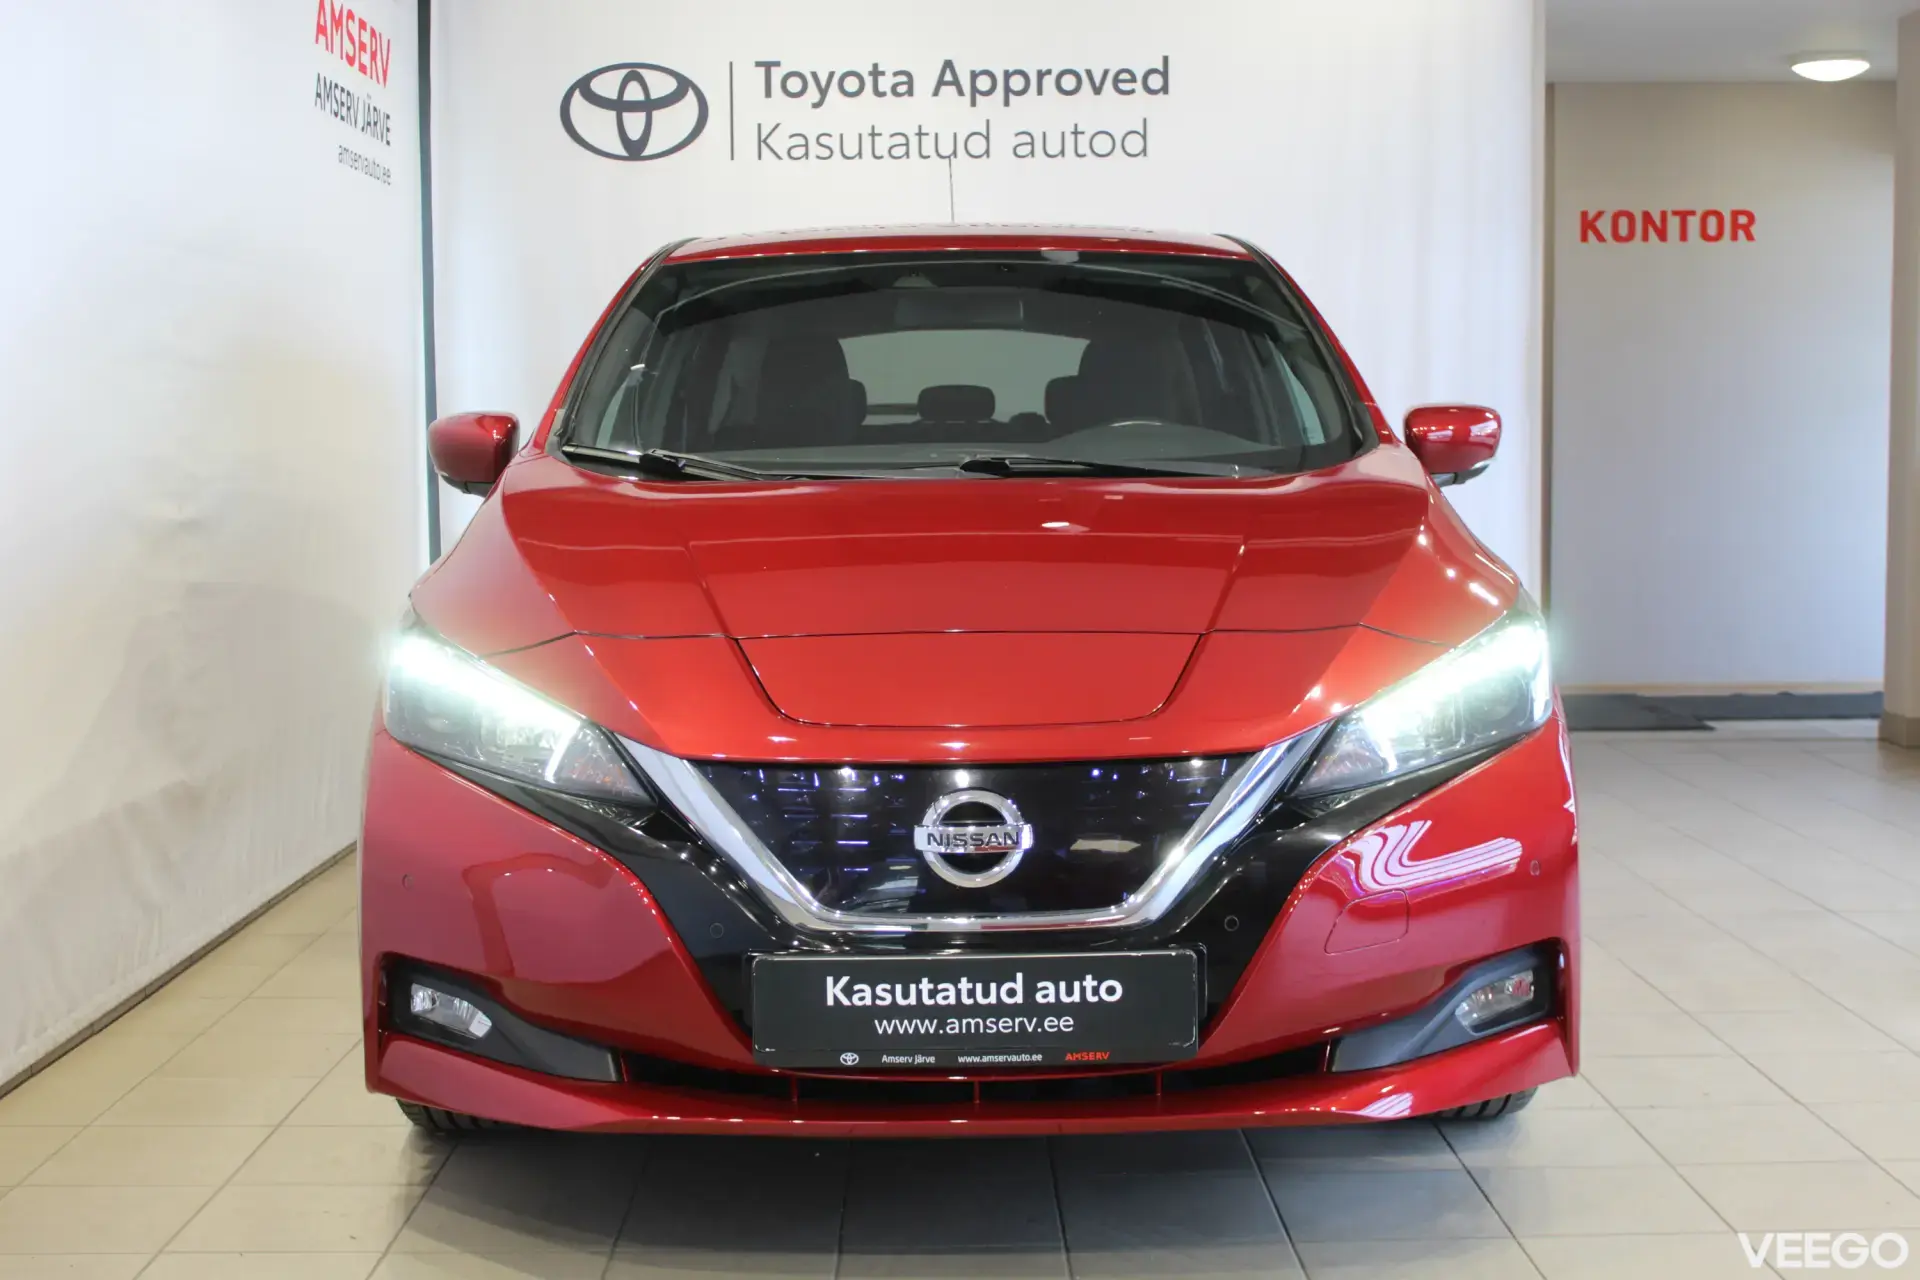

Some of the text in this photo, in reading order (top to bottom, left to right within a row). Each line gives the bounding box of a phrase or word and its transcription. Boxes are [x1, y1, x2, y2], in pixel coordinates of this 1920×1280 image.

[315, 0, 391, 88] AMSERV
[754, 55, 1171, 109] Toyota Approved
[314, 72, 391, 147] AMSERV JÄRVE
[755, 118, 1149, 160] Kasutatud autod
[338, 144, 392, 186] amservauto.ee
[1579, 209, 1756, 243] KONTOR
[927, 832, 1020, 847] NISSAN
[826, 973, 1123, 1006] Kasutatud auto
[874, 1014, 1074, 1034] www.amserv.ee
[881, 1054, 912, 1064] Amserv
[957, 1053, 1043, 1064] www.amservauto.ee
[1065, 1052, 1110, 1061] AMSERV
